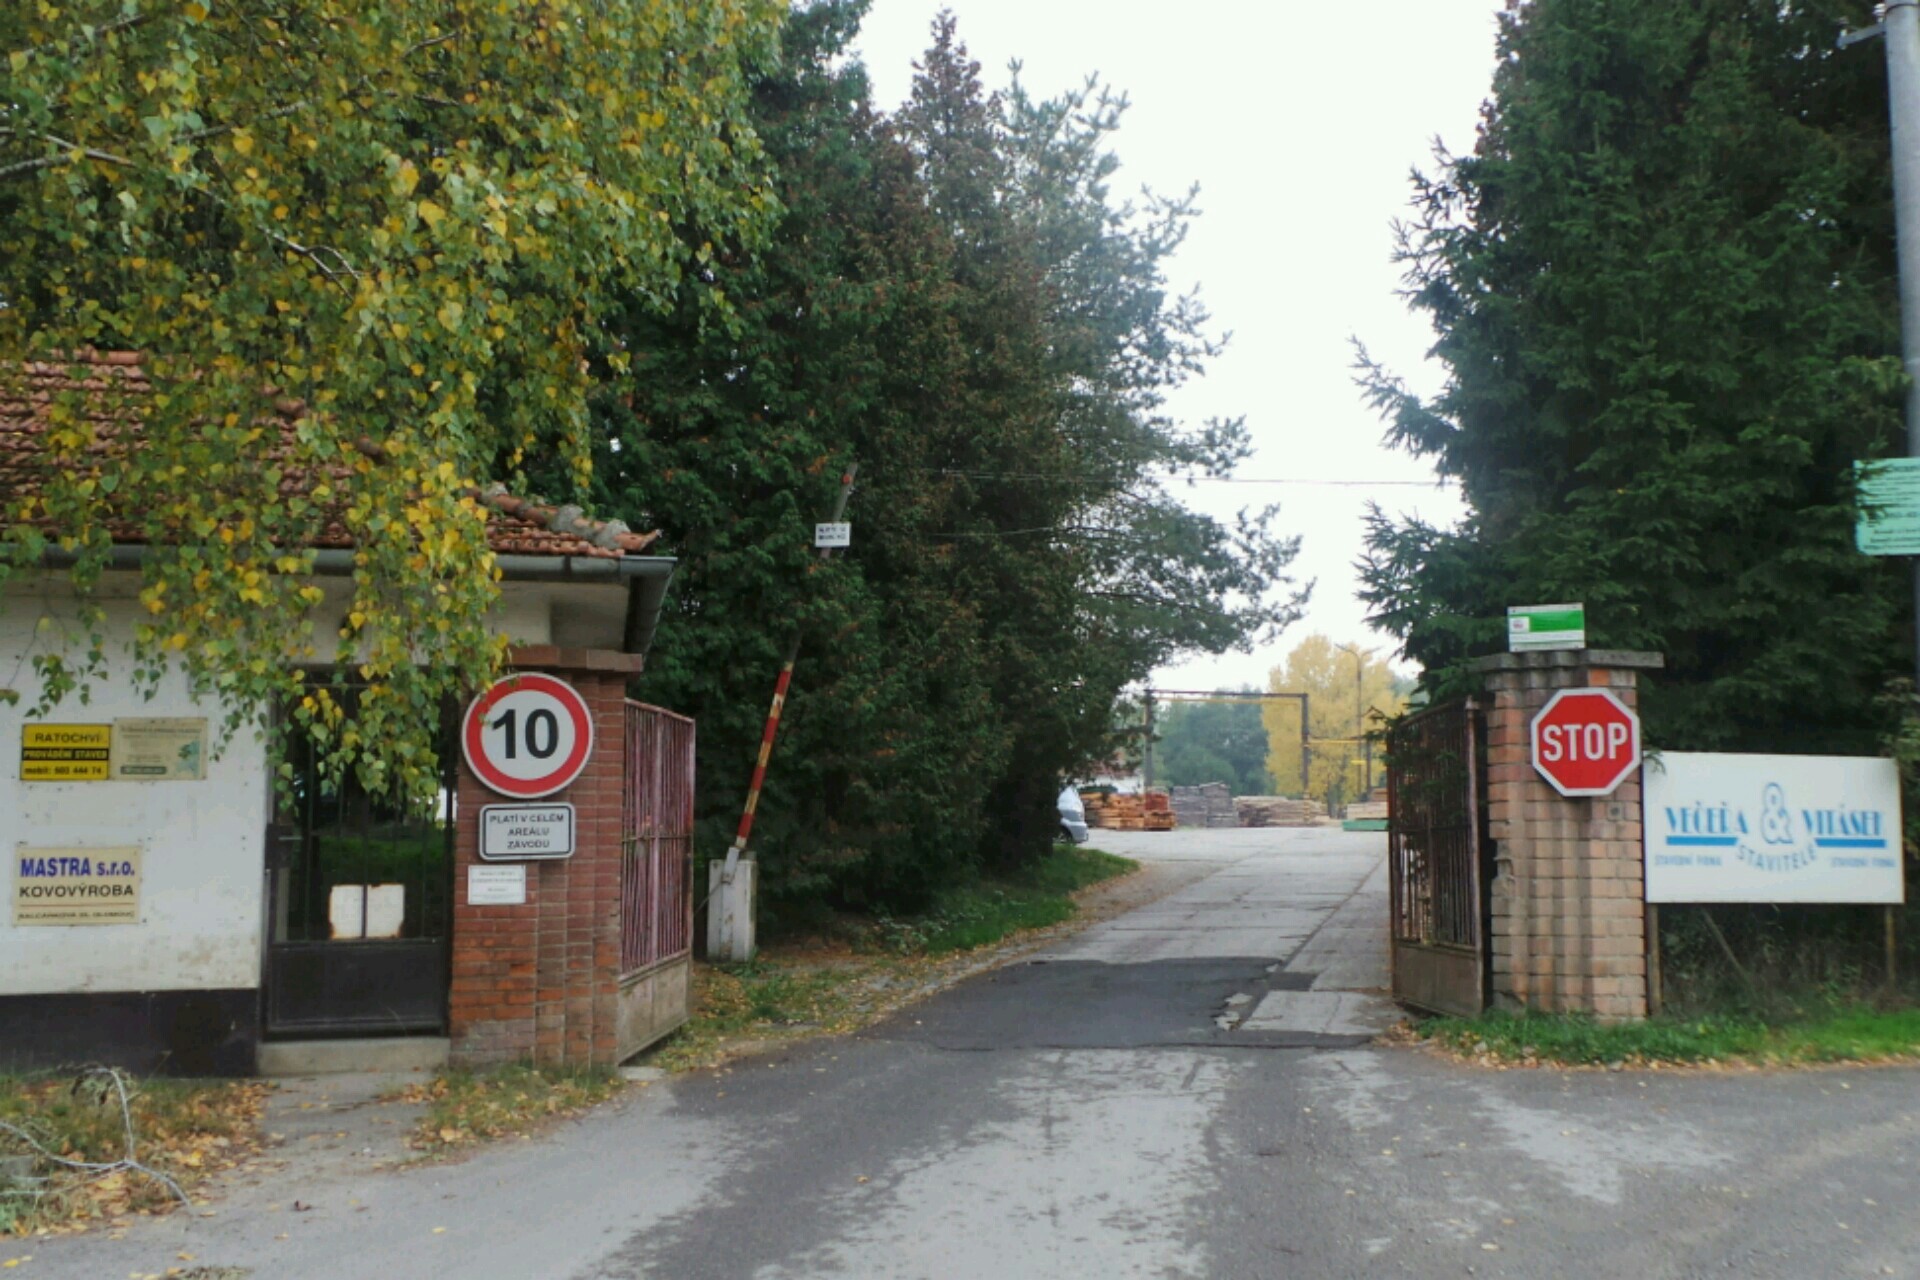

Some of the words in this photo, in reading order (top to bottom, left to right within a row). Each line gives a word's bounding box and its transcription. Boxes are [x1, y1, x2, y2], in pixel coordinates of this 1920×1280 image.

[491, 708, 559, 759] 10
[1543, 722, 1628, 761] STOP
[20, 857, 91, 878] MASTRA
[96, 862, 135, 876] s.r.o.
[19, 883, 134, 898] KOVOVÝROBA
